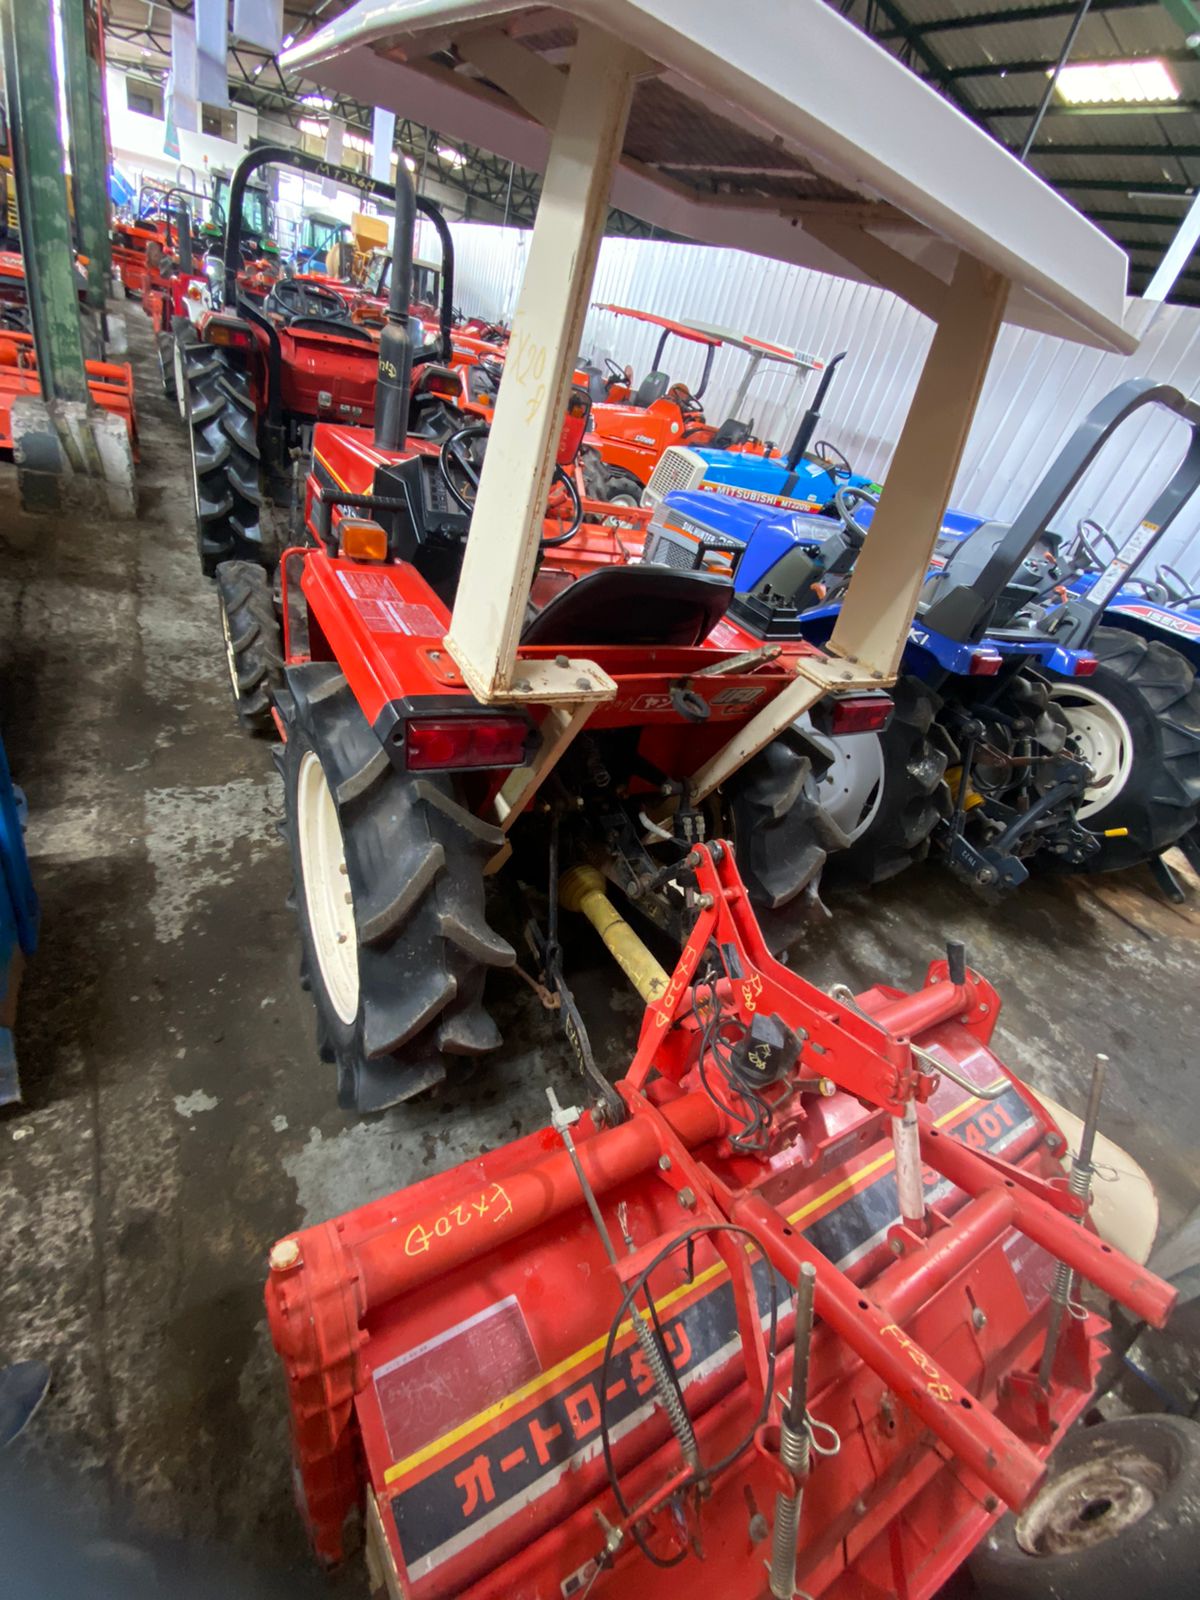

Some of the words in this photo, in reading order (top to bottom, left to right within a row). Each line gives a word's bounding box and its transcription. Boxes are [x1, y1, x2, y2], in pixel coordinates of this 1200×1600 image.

[716, 485, 778, 507] MITSUBISHI
[1146, 609, 1189, 632] ISEKI
[404, 1182, 513, 1257] FX20D
